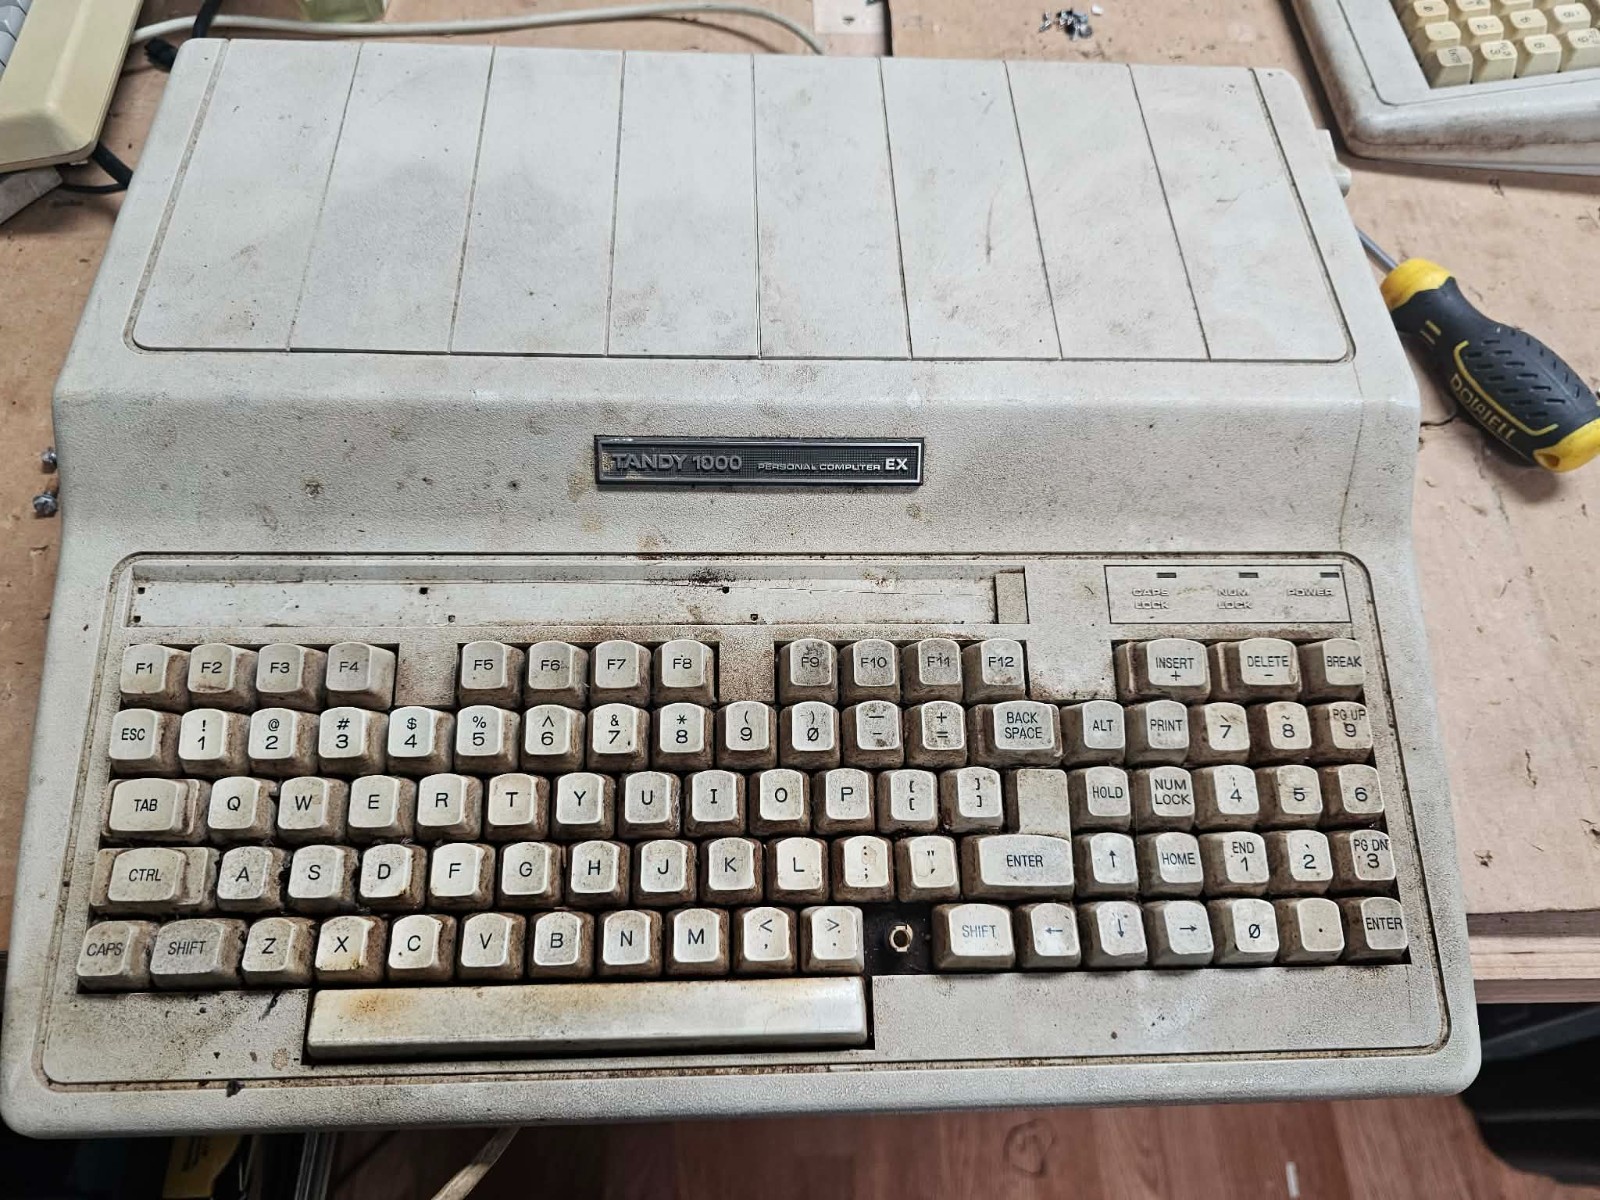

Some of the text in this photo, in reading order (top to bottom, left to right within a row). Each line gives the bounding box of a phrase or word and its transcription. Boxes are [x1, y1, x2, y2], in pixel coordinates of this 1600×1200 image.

[612, 454, 908, 471] TANDY 1000 PERSONAL COMPUTER EX
[1132, 588, 1170, 596] CAPS
[1217, 588, 1249, 596] NUM
[1287, 588, 1334, 596] POWER
[1134, 600, 1169, 609] LOCK
[1218, 600, 1252, 609] LOCK
[200, 661, 223, 674] F2
[270, 661, 290, 674] F3
[339, 661, 359, 673] F4
[473, 659, 494, 671] F5
[540, 659, 560, 671] F6
[607, 658, 626, 670] F7
[673, 657, 692, 670] F8
[801, 657, 820, 668] F9
[860, 657, 887, 668] F10
[927, 657, 950, 667] F11
[988, 656, 1014, 667] F12
[1155, 657, 1195, 669] INSERT
[1247, 655, 1289, 668] DELETE
[1326, 655, 1362, 667] BREAK
[135, 663, 153, 675] F1
[1006, 711, 1038, 724] BACK
[1332, 708, 1366, 721] PG UP
[1092, 719, 1114, 732] ALT
[1150, 719, 1183, 732] PRINT
[1219, 725, 1232, 739] 7
[1282, 724, 1295, 738] 8
[1344, 723, 1357, 737] 9
[121, 728, 145, 741] ESC
[472, 732, 485, 746] 5
[541, 731, 554, 746] 6
[608, 730, 621, 745] 7
[676, 730, 688, 744] 8
[740, 727, 753, 741] 9
[1004, 727, 1042, 739] SPACE
[197, 738, 206, 750] 1
[265, 736, 279, 750] 2
[335, 734, 349, 748] 3
[403, 734, 417, 748] 4
[1154, 778, 1187, 791] NUM
[435, 792, 449, 807] R
[505, 792, 519, 807] T
[573, 790, 587, 806] Y
[641, 790, 653, 805] U
[710, 788, 718, 804] I
[775, 788, 788, 802] O
[841, 787, 854, 801] P
[1092, 786, 1123, 799] HOLD
[1154, 793, 1191, 806] LOCK
[1230, 788, 1243, 802] 4
[1293, 787, 1306, 802] 5
[1355, 787, 1368, 802] 6
[133, 799, 158, 812] TAB
[227, 796, 241, 811] Q
[295, 796, 312, 811] W
[368, 794, 380, 809] E
[1232, 841, 1255, 854] END
[1354, 839, 1389, 852] PG DN
[725, 857, 738, 872] K
[792, 857, 805, 872] L
[1006, 854, 1044, 867] ENTER
[1161, 853, 1196, 865] HOME
[1240, 857, 1249, 872] 1
[1303, 854, 1316, 870] 2
[1367, 853, 1380, 869] 3
[236, 867, 249, 882] A
[307, 865, 321, 880] S
[377, 865, 391, 879] D
[449, 863, 462, 878] F
[519, 862, 533, 877] G
[588, 860, 601, 876] H
[657, 860, 670, 875] J
[128, 868, 162, 882] CTRL
[1366, 917, 1403, 930] ENTER
[620, 931, 633, 947] N
[687, 929, 705, 945] M
[962, 925, 996, 939] SHIFT
[167, 940, 207, 955] SHIFT
[262, 938, 276, 954] Z
[334, 937, 349, 952] X
[407, 935, 422, 951] C
[480, 933, 493, 950] V
[550, 932, 564, 949] B
[86, 942, 123, 956] CAPS
